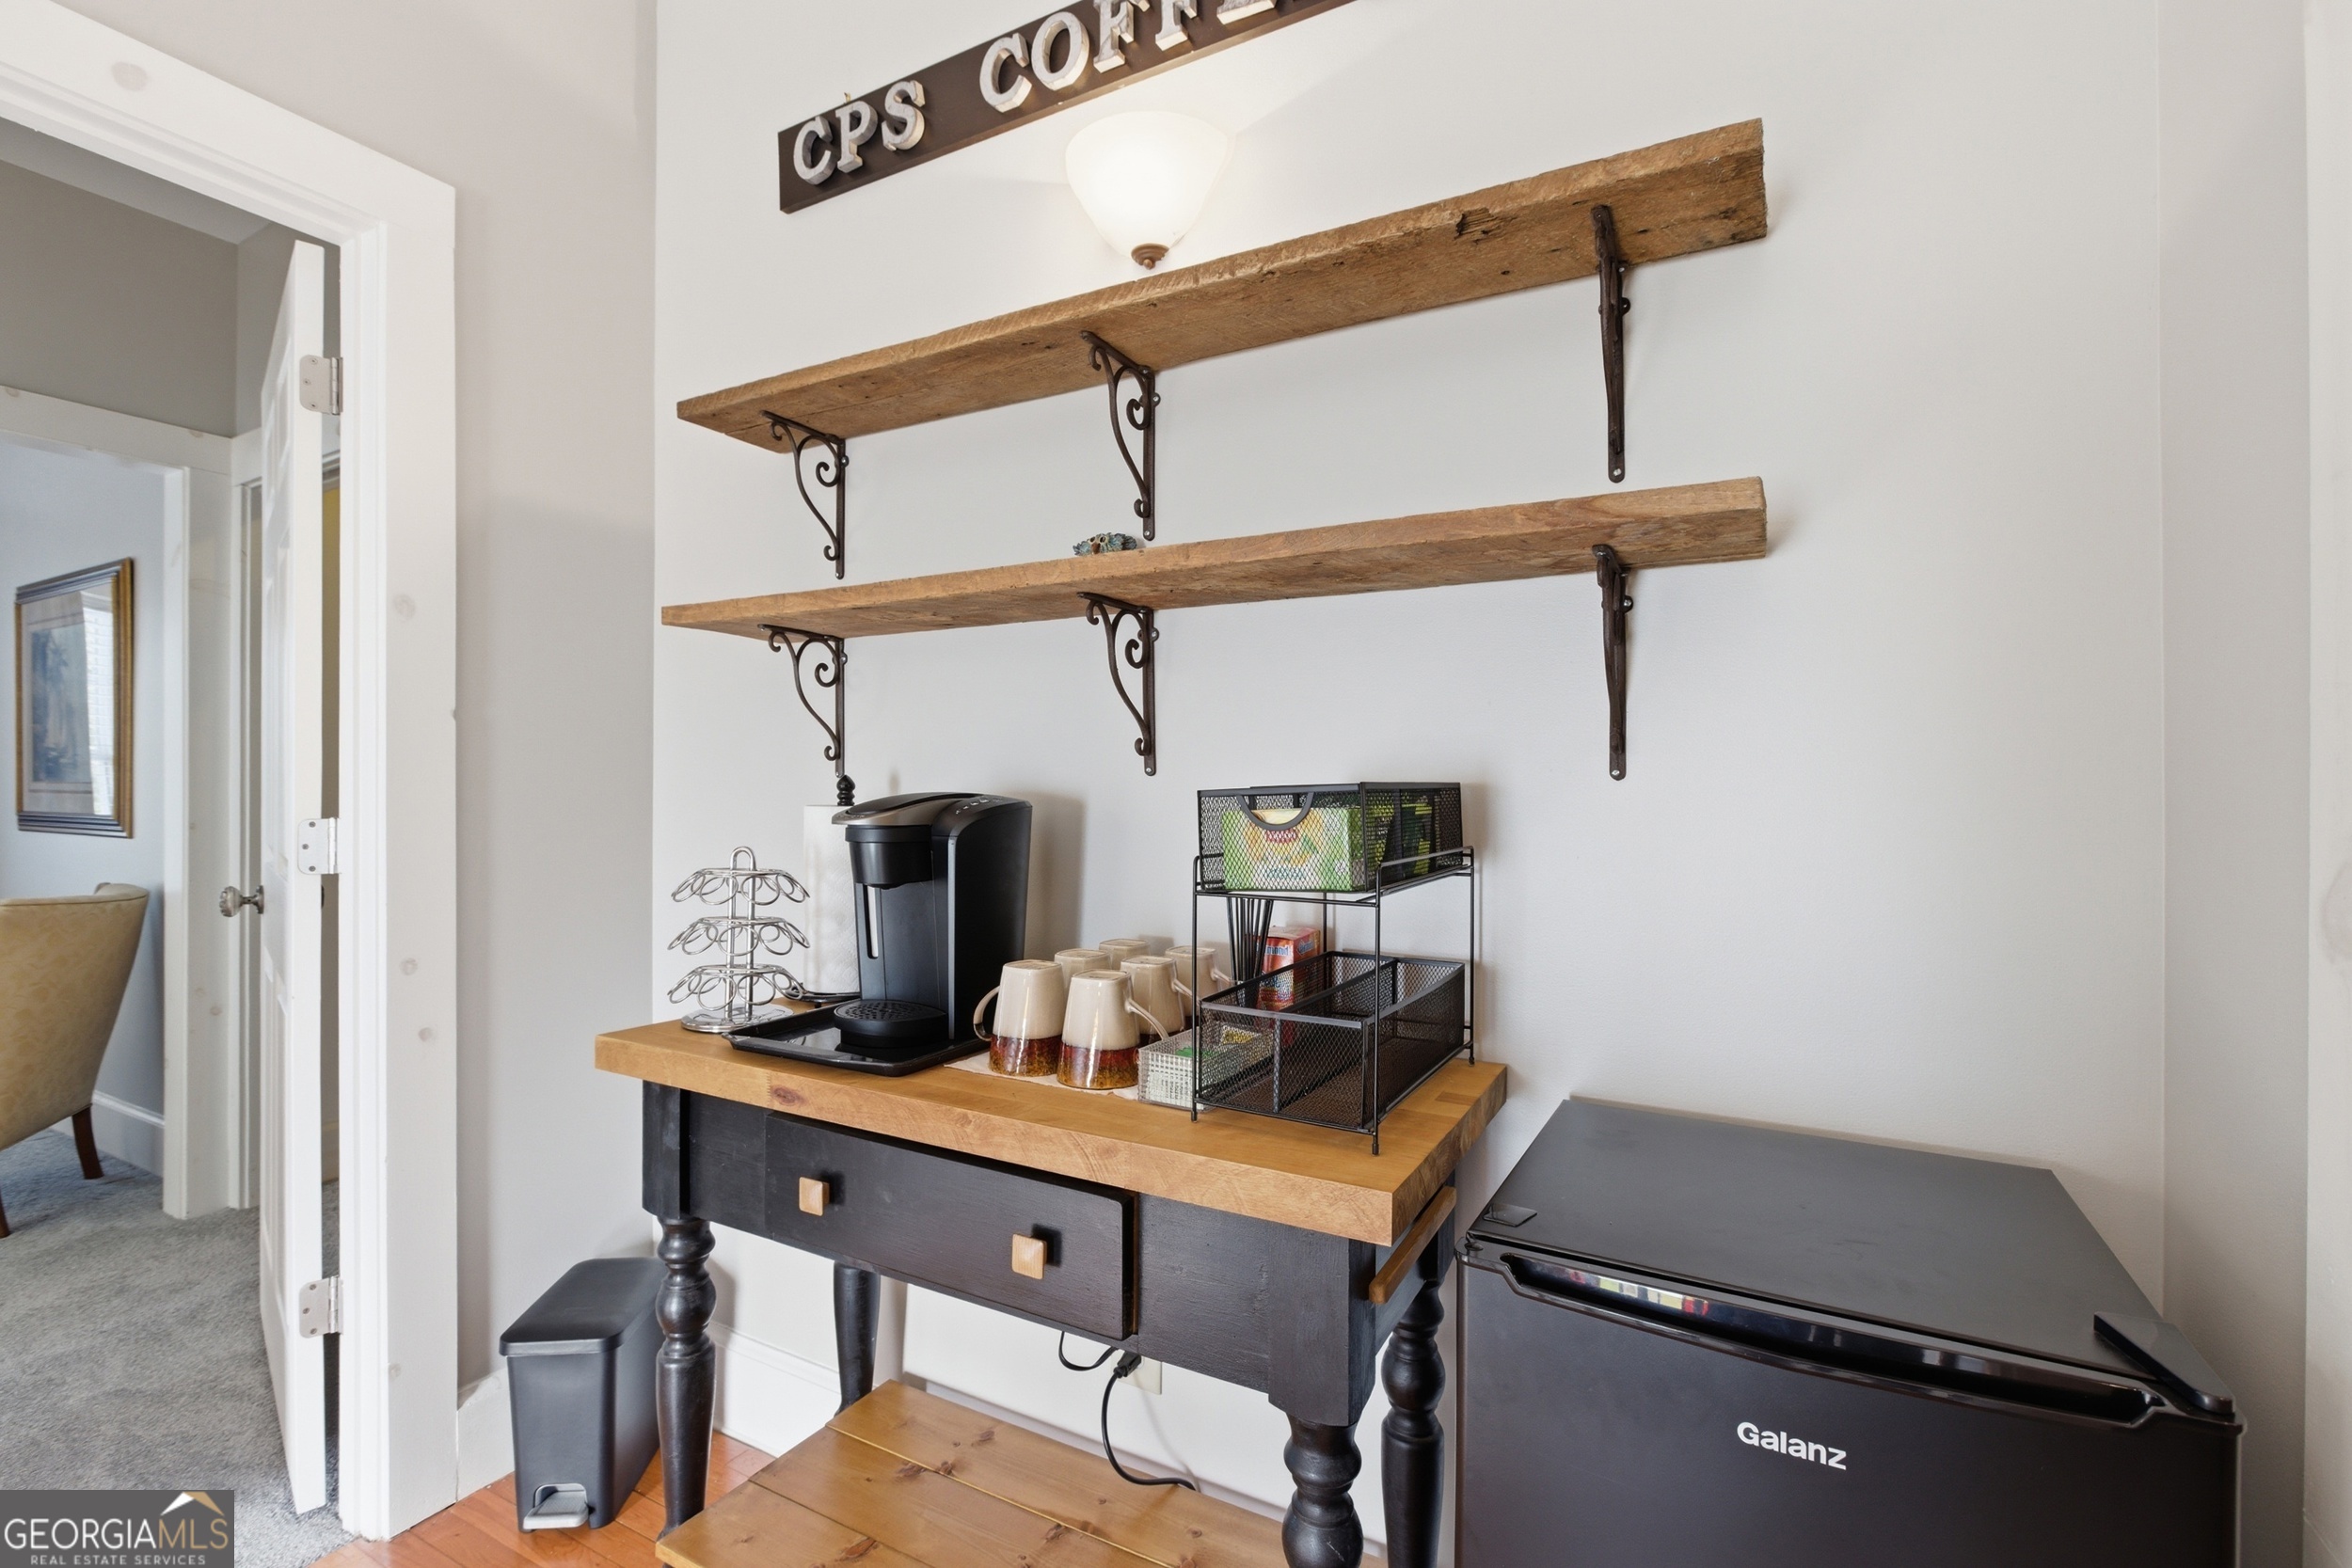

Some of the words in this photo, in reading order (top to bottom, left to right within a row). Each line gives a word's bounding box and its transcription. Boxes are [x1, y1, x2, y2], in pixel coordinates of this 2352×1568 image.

[792, 80, 926, 184] CPS
[979, 0, 1276, 113] COFF
[1737, 1421, 1847, 1471] Galanz
